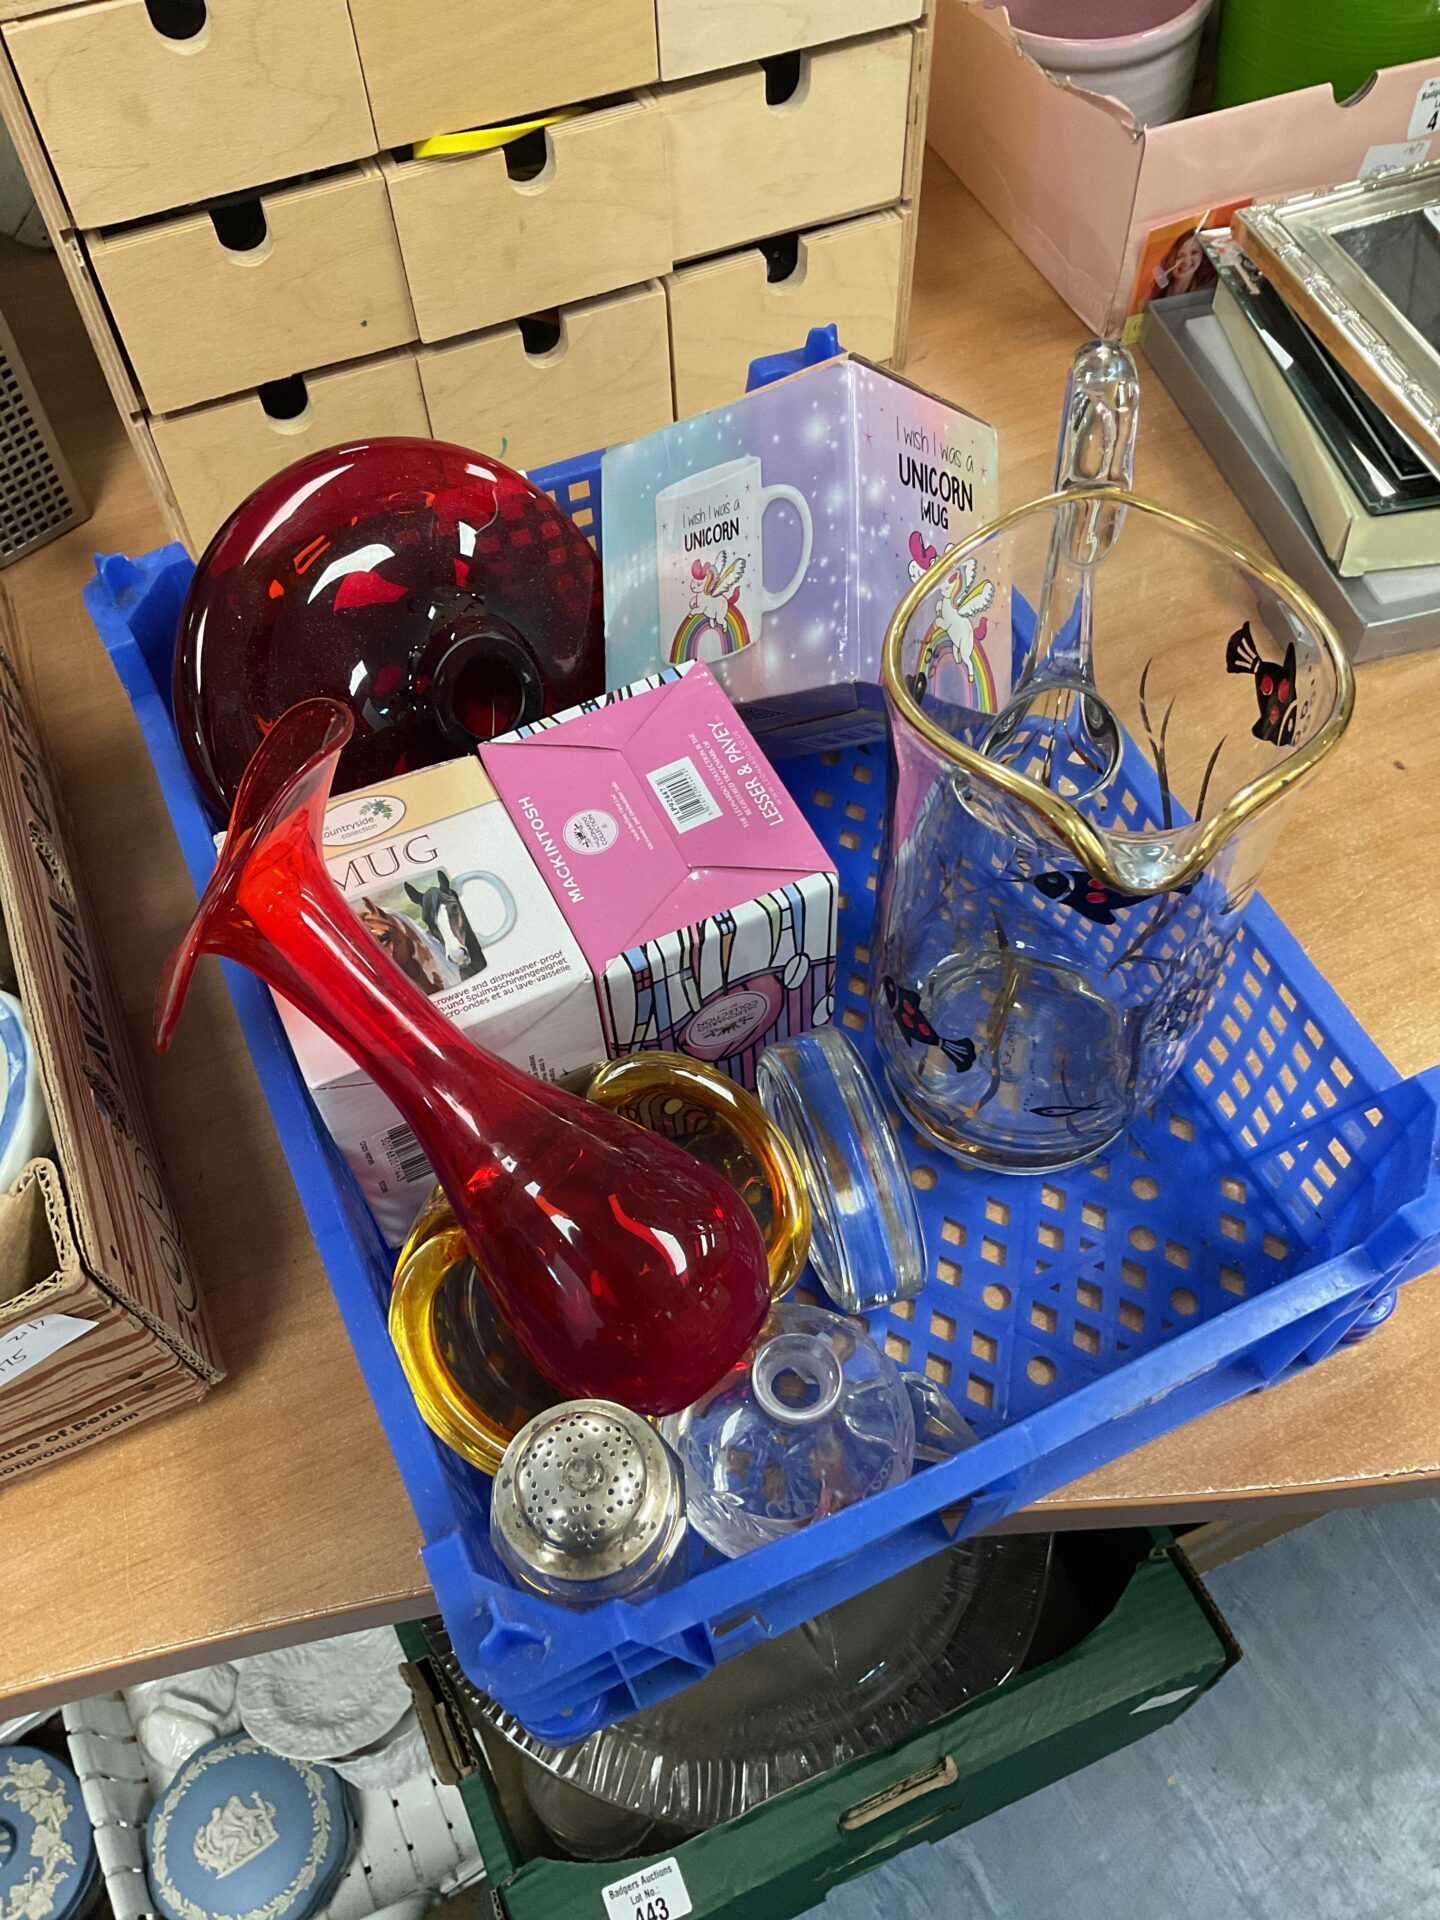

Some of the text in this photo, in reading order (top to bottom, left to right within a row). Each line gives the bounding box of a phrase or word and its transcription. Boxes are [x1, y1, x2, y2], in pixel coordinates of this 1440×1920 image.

[895, 414, 974, 473] I wish I was a
[898, 452, 973, 513] UNICORN
[687, 507, 706, 527] wish
[713, 502, 731, 518] was
[734, 498, 740, 511] a
[920, 496, 949, 530] MUG
[684, 516, 740, 552] UNICORN
[697, 748, 724, 785] COLLECTION
[706, 720, 784, 825] LESSER & PAVEY
[707, 748, 731, 781] TRADEMARK
[658, 786, 680, 814] LP92447
[719, 784, 742, 816] LEONARDO
[727, 781, 752, 815] REGISTERED
[322, 815, 375, 839] ountryside
[341, 822, 378, 840] collection
[581, 816, 600, 843] LEONARDO
[586, 813, 608, 845] COLLECTION
[332, 834, 439, 892] MUG
[517, 795, 584, 902] MACKINTOSH
[433, 949, 563, 1007] crowave and dishwasher-proof
[438, 956, 567, 1013] n-und Spülmaschinengeeignet
[446, 963, 571, 1019] cro-ondes et au lave-vaisselle
[696, 999, 757, 1027] COLLECTION
[696, 1008, 747, 1032] LEONARDO
[45, 1428, 68, 1443] of
[71, 1404, 124, 1431] Peru
[0, 1410, 140, 1477] onproduce.com
[608, 1865, 673, 1900] Badgers Auctions
[629, 1892, 643, 1906] Lot
[636, 1897, 670, 1920] 443
